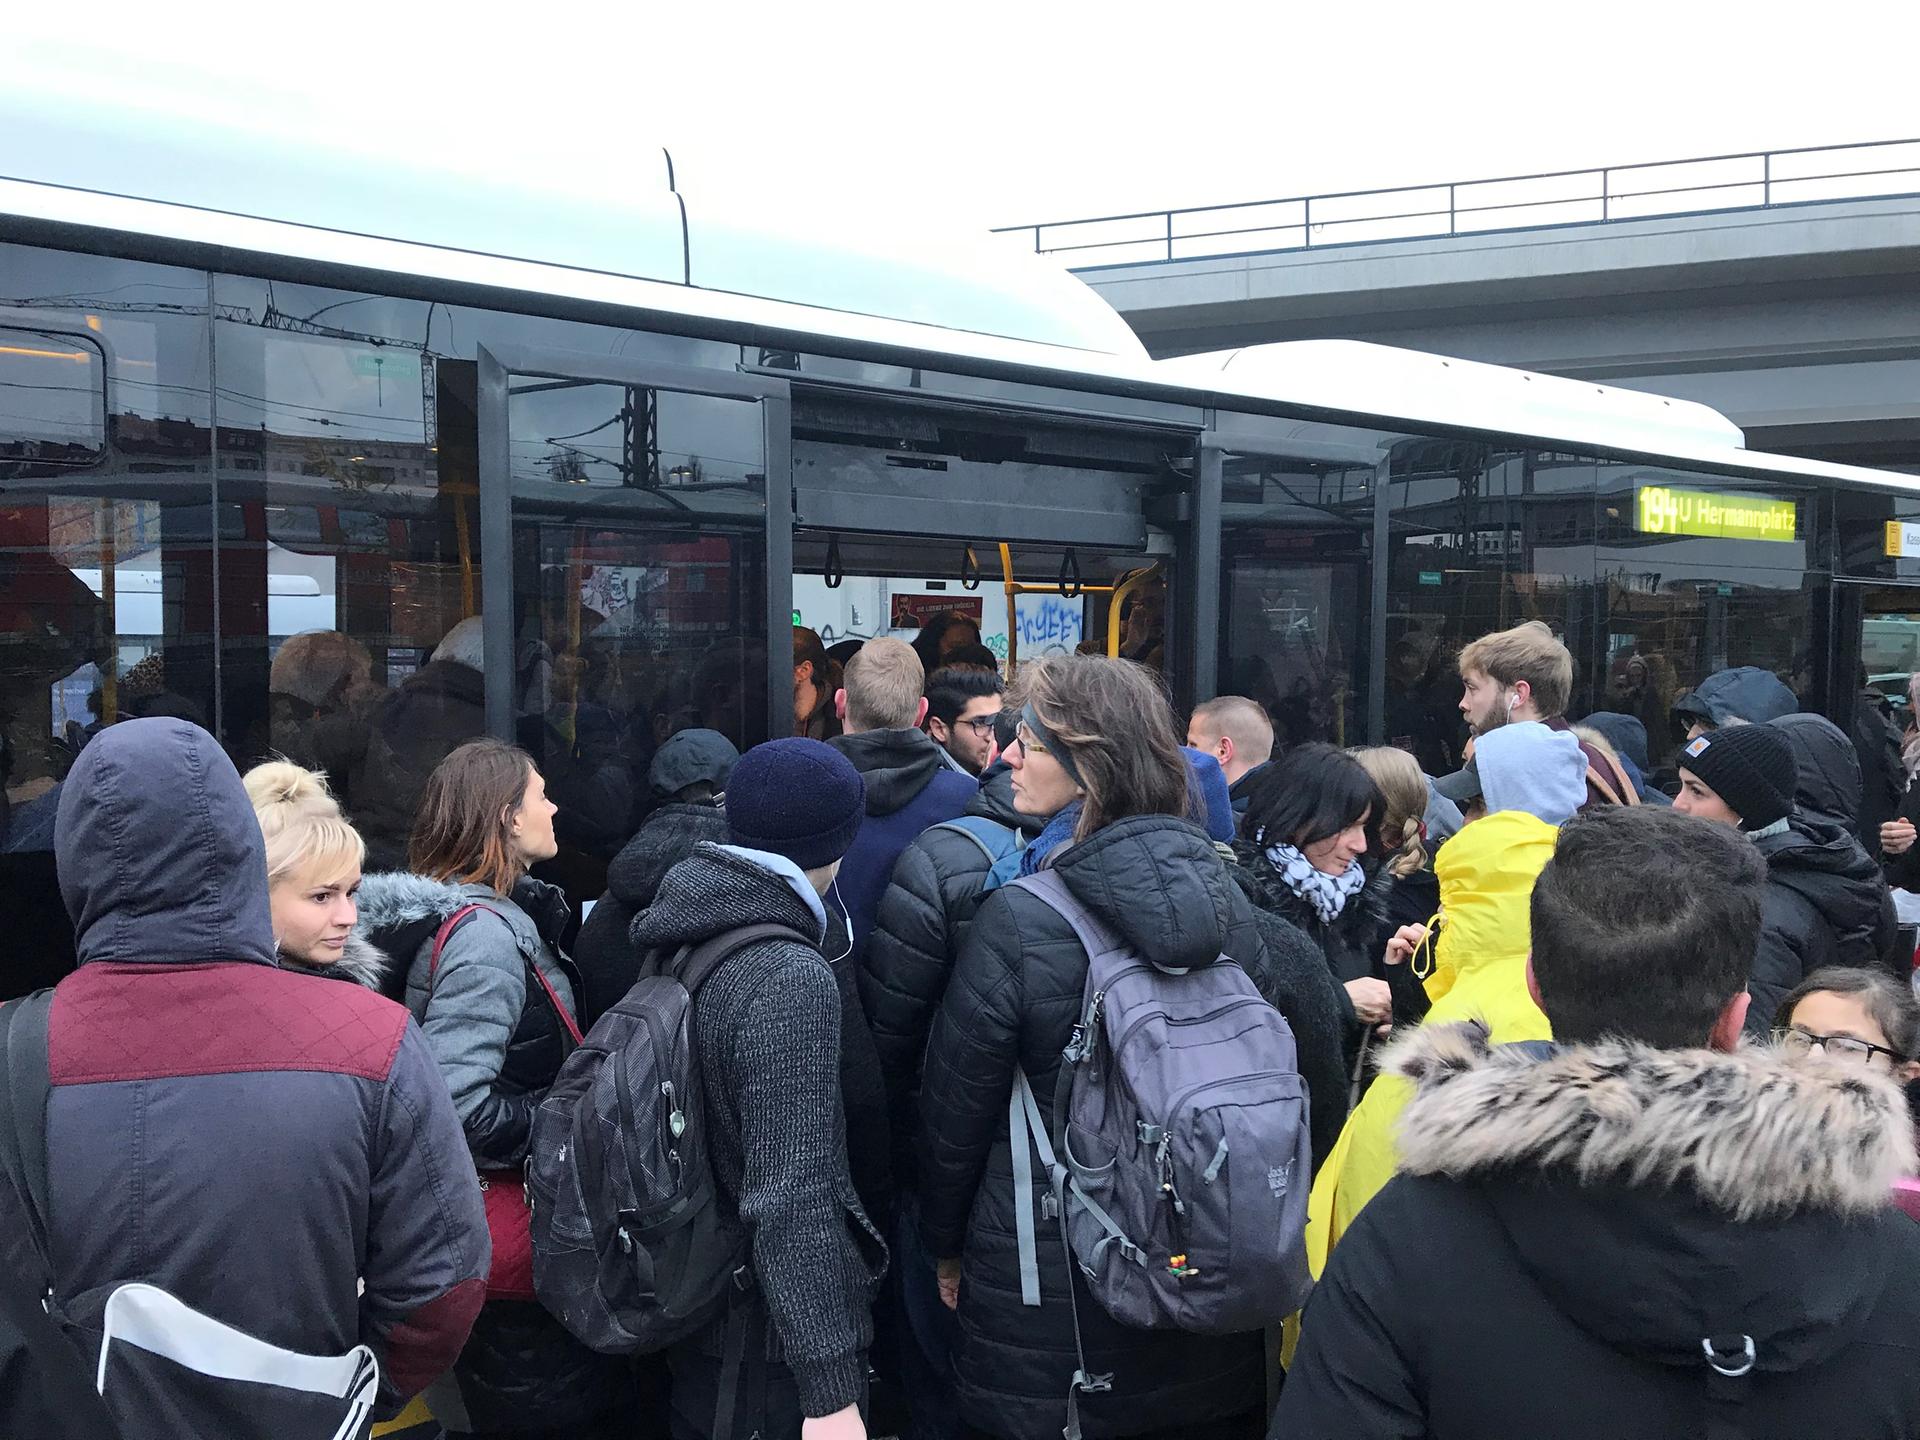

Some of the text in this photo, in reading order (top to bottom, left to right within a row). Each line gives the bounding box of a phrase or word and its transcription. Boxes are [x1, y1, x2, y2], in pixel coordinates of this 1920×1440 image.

[1640, 486, 1796, 534] 194 U Hermannplatz
